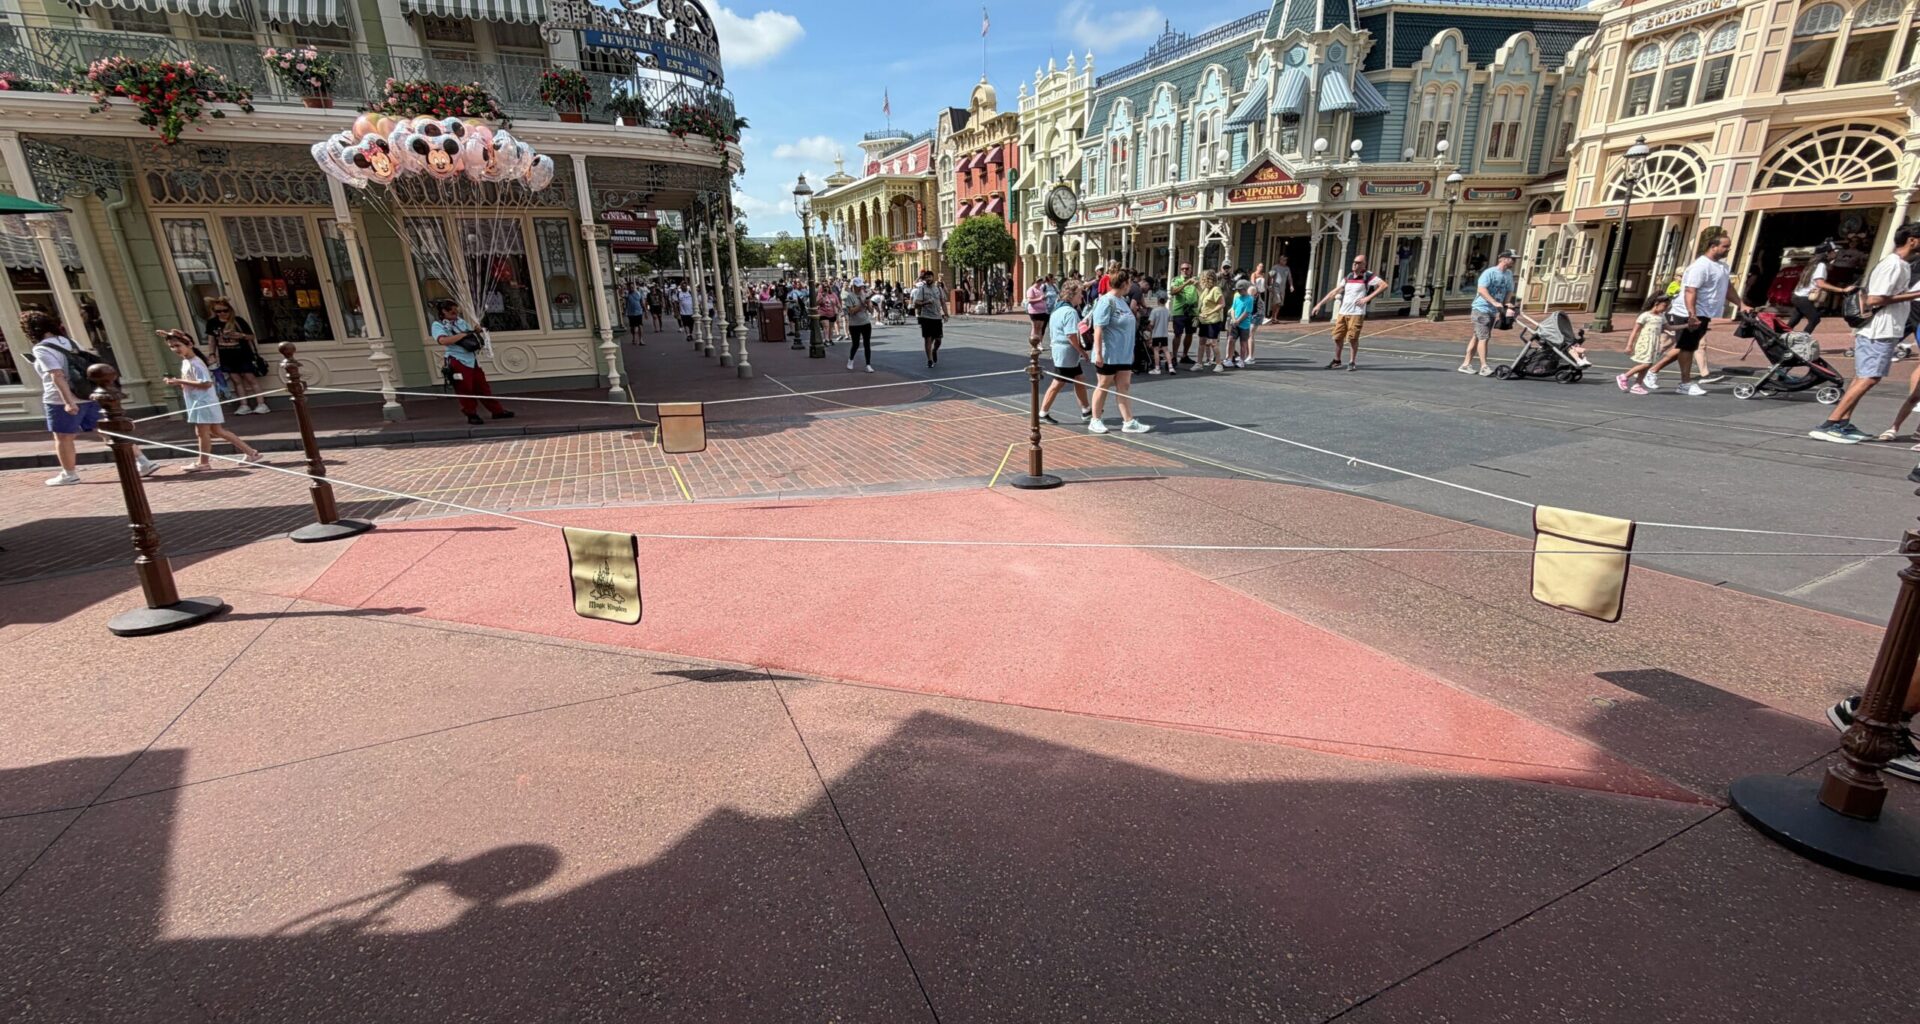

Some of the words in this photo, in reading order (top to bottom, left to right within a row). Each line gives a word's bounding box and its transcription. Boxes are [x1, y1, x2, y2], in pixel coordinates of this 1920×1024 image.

[549, 1, 667, 37] UPTOWN
[1645, 0, 1720, 29] EMPORIUM
[600, 34, 653, 50] JEWELRY
[664, 45, 692, 62] CHINA
[666, 58, 686, 72] EST.
[1233, 185, 1297, 198] EMPORIUM
[1395, 185, 1417, 193] BEARS
[601, 211, 634, 221] CINEMA
[589, 601, 605, 609] Magic
